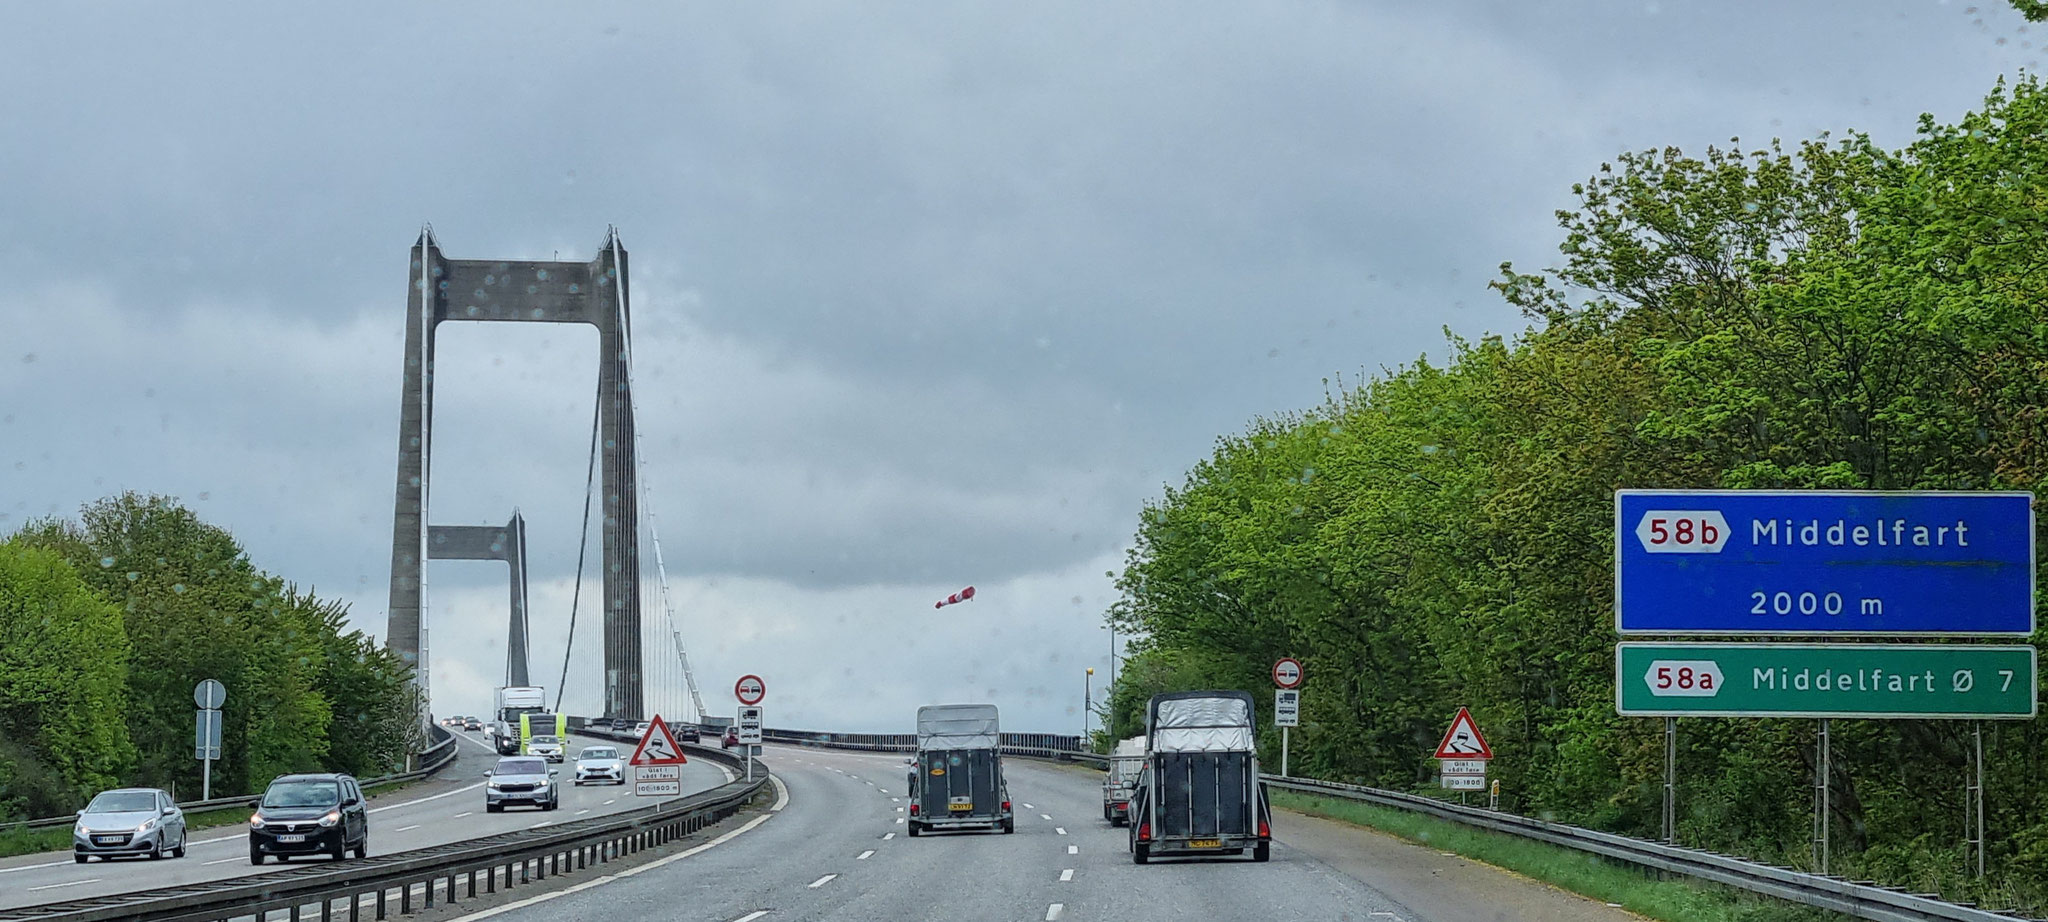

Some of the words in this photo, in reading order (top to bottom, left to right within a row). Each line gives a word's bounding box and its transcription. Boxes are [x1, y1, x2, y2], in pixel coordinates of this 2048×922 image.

[1650, 518, 1719, 545] 58b
[1752, 518, 1969, 547] Middelfart
[1750, 592, 1843, 615] 2000
[1861, 598, 1883, 615] m
[1656, 667, 1714, 690] 58a
[1752, 667, 1935, 692] Middelfart
[1953, 669, 1974, 692] Ø
[1998, 669, 2014, 692] 7
